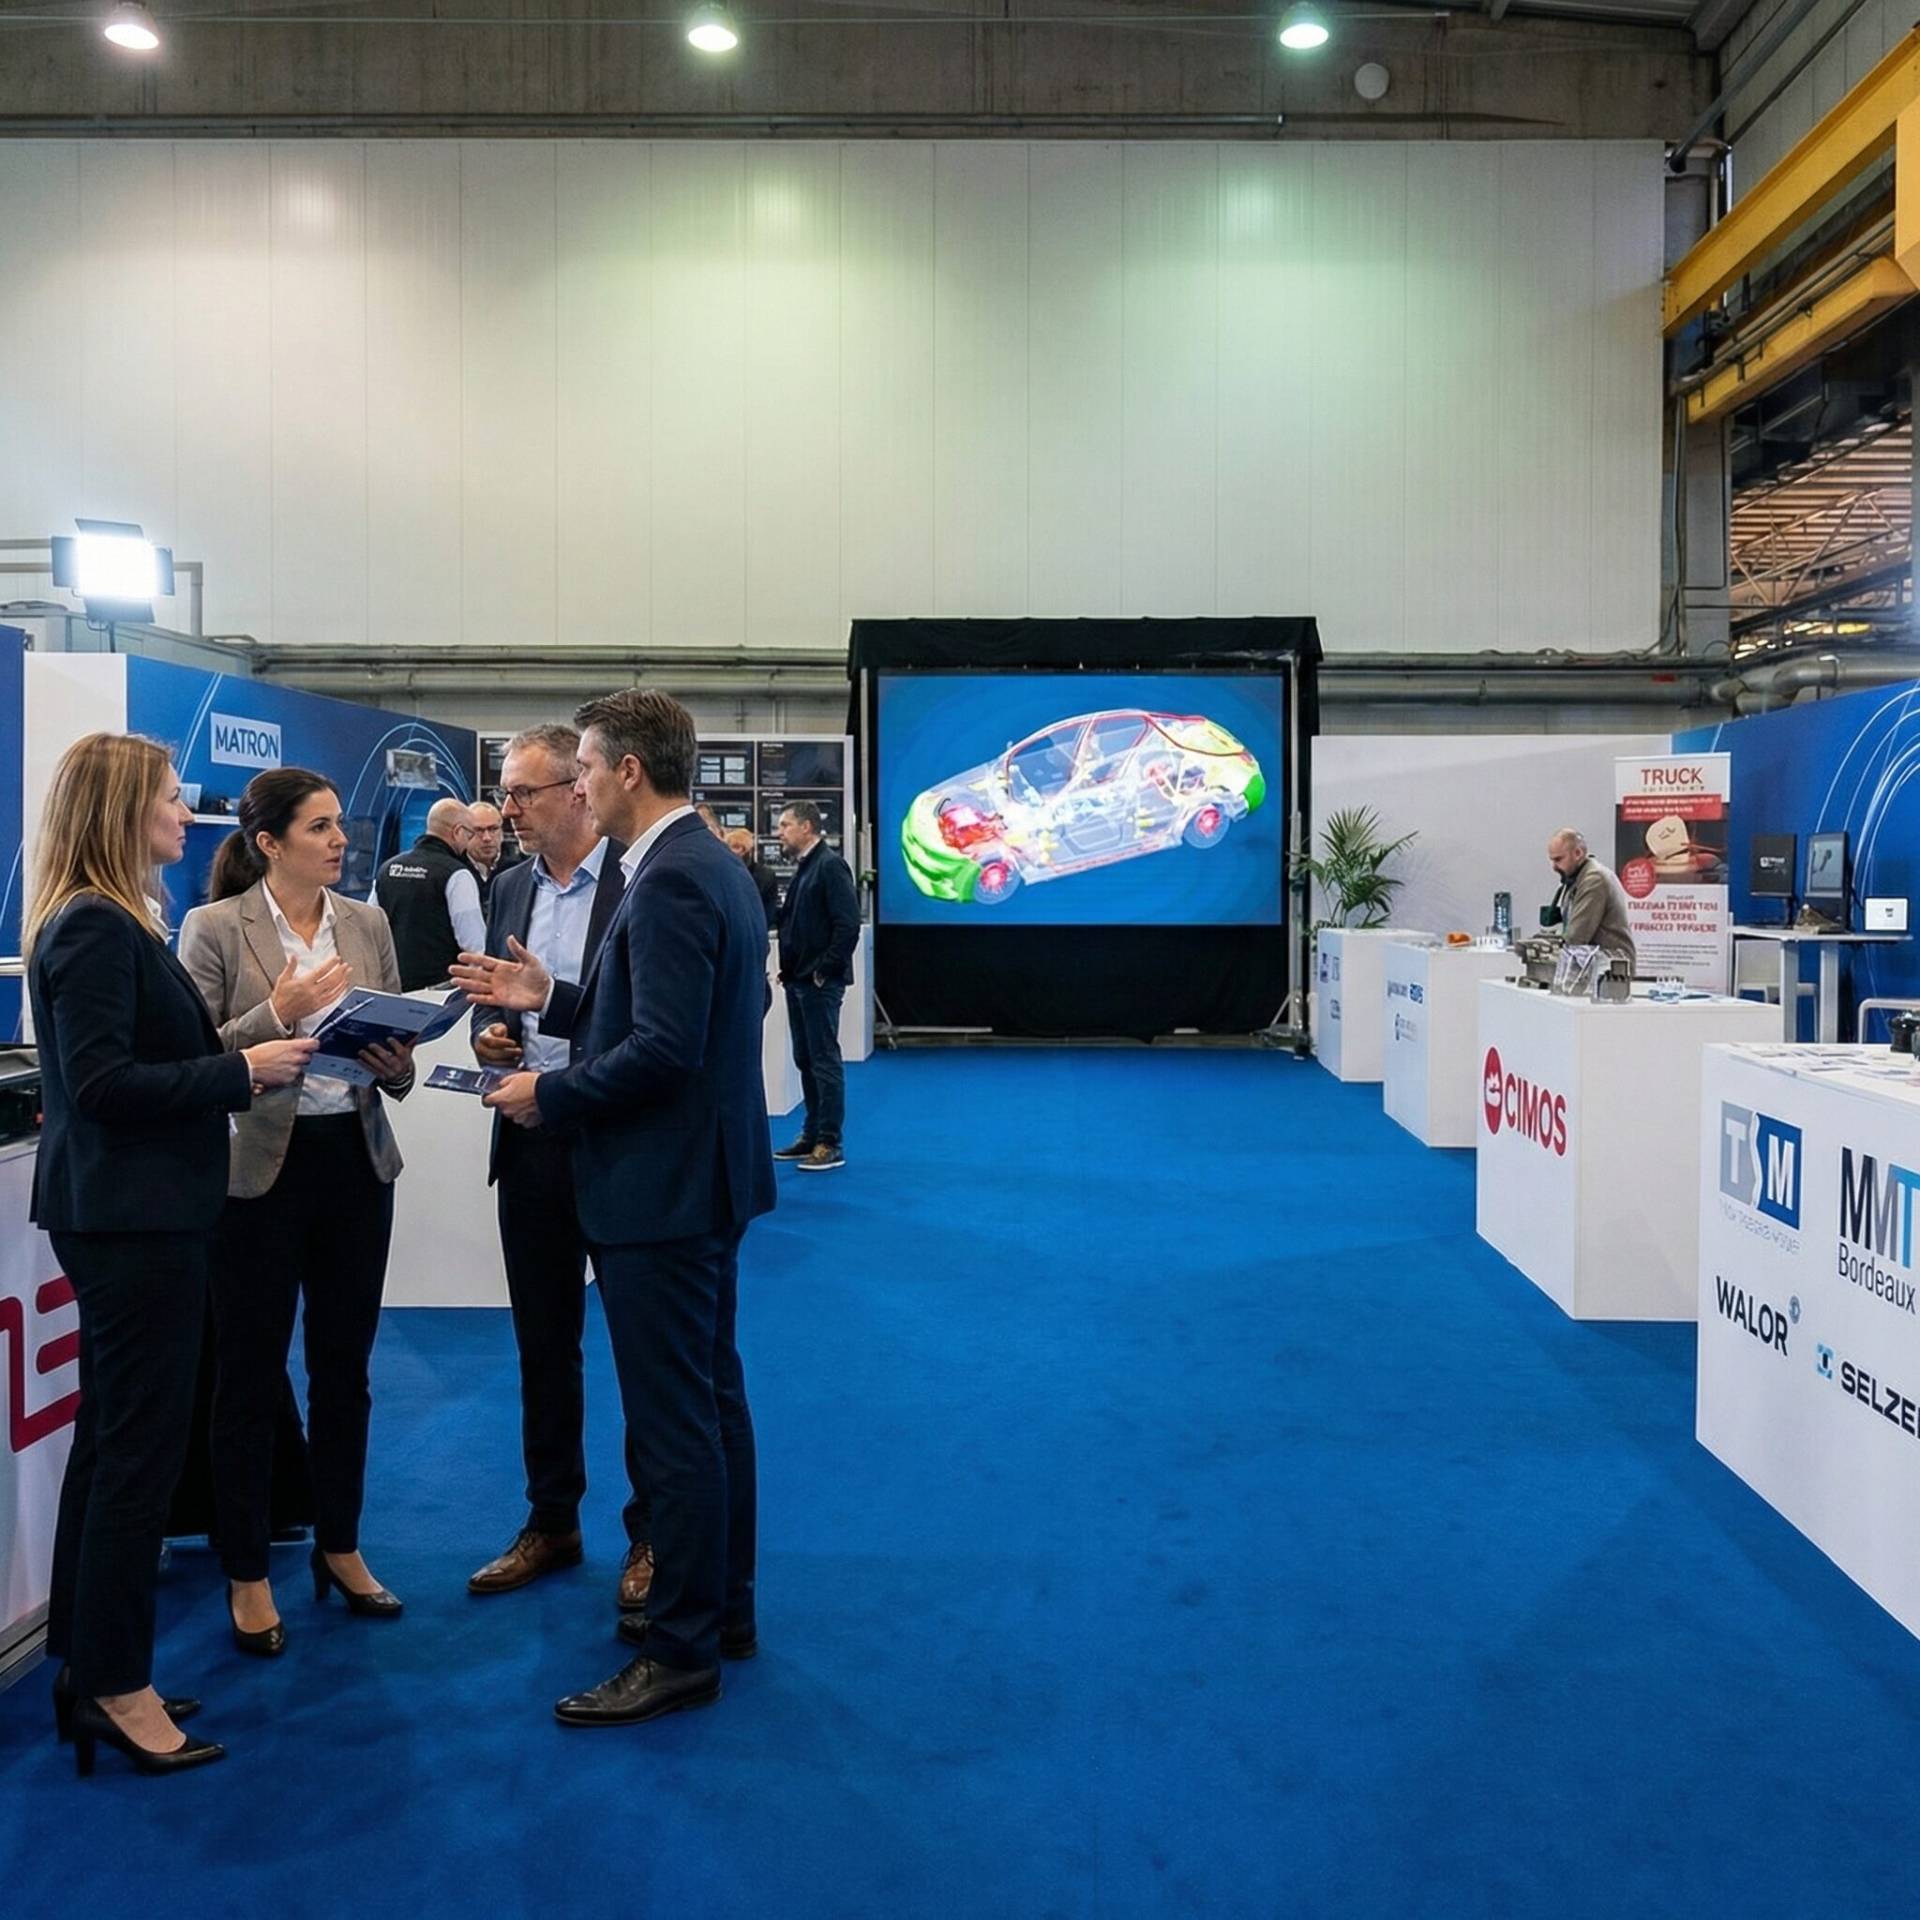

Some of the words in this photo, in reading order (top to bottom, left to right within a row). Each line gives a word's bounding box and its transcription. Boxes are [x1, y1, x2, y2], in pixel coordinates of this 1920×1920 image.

[215, 724, 279, 759] MATRON
[1641, 767, 1703, 785] TRUCK
[1505, 1072, 1567, 1157] CIMOS
[1840, 1146, 1920, 1269] MMT
[1716, 1275, 1788, 1356] WALOR
[1838, 1242, 1916, 1315] Bordeaux
[1841, 1361, 1920, 1440] SELZE
